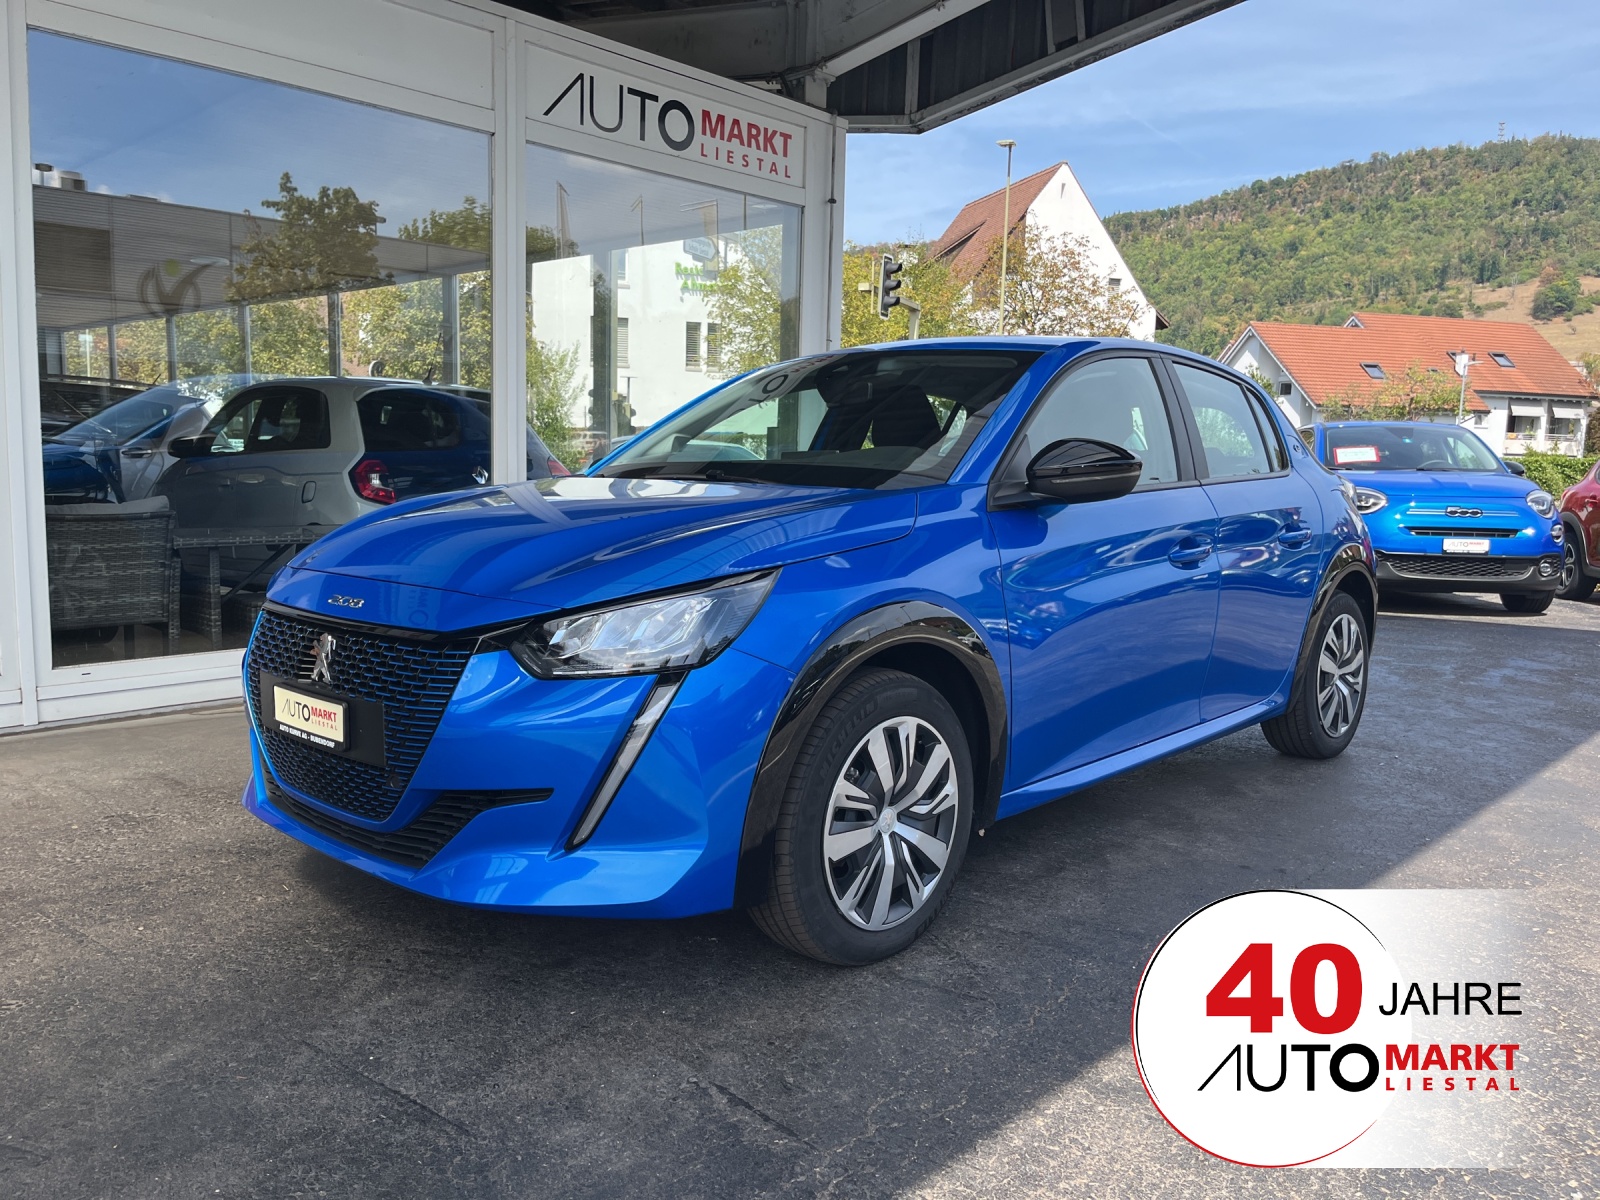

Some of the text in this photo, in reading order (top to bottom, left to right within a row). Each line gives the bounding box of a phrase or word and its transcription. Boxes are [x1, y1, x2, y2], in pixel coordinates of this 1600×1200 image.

[543, 73, 792, 158] AUTO MARKT
[701, 143, 791, 178] LIESTAL
[1447, 506, 1482, 517] 500
[328, 594, 365, 608] 208
[282, 698, 337, 722] AUTO MARKT
[311, 718, 337, 731] LIESTAL
